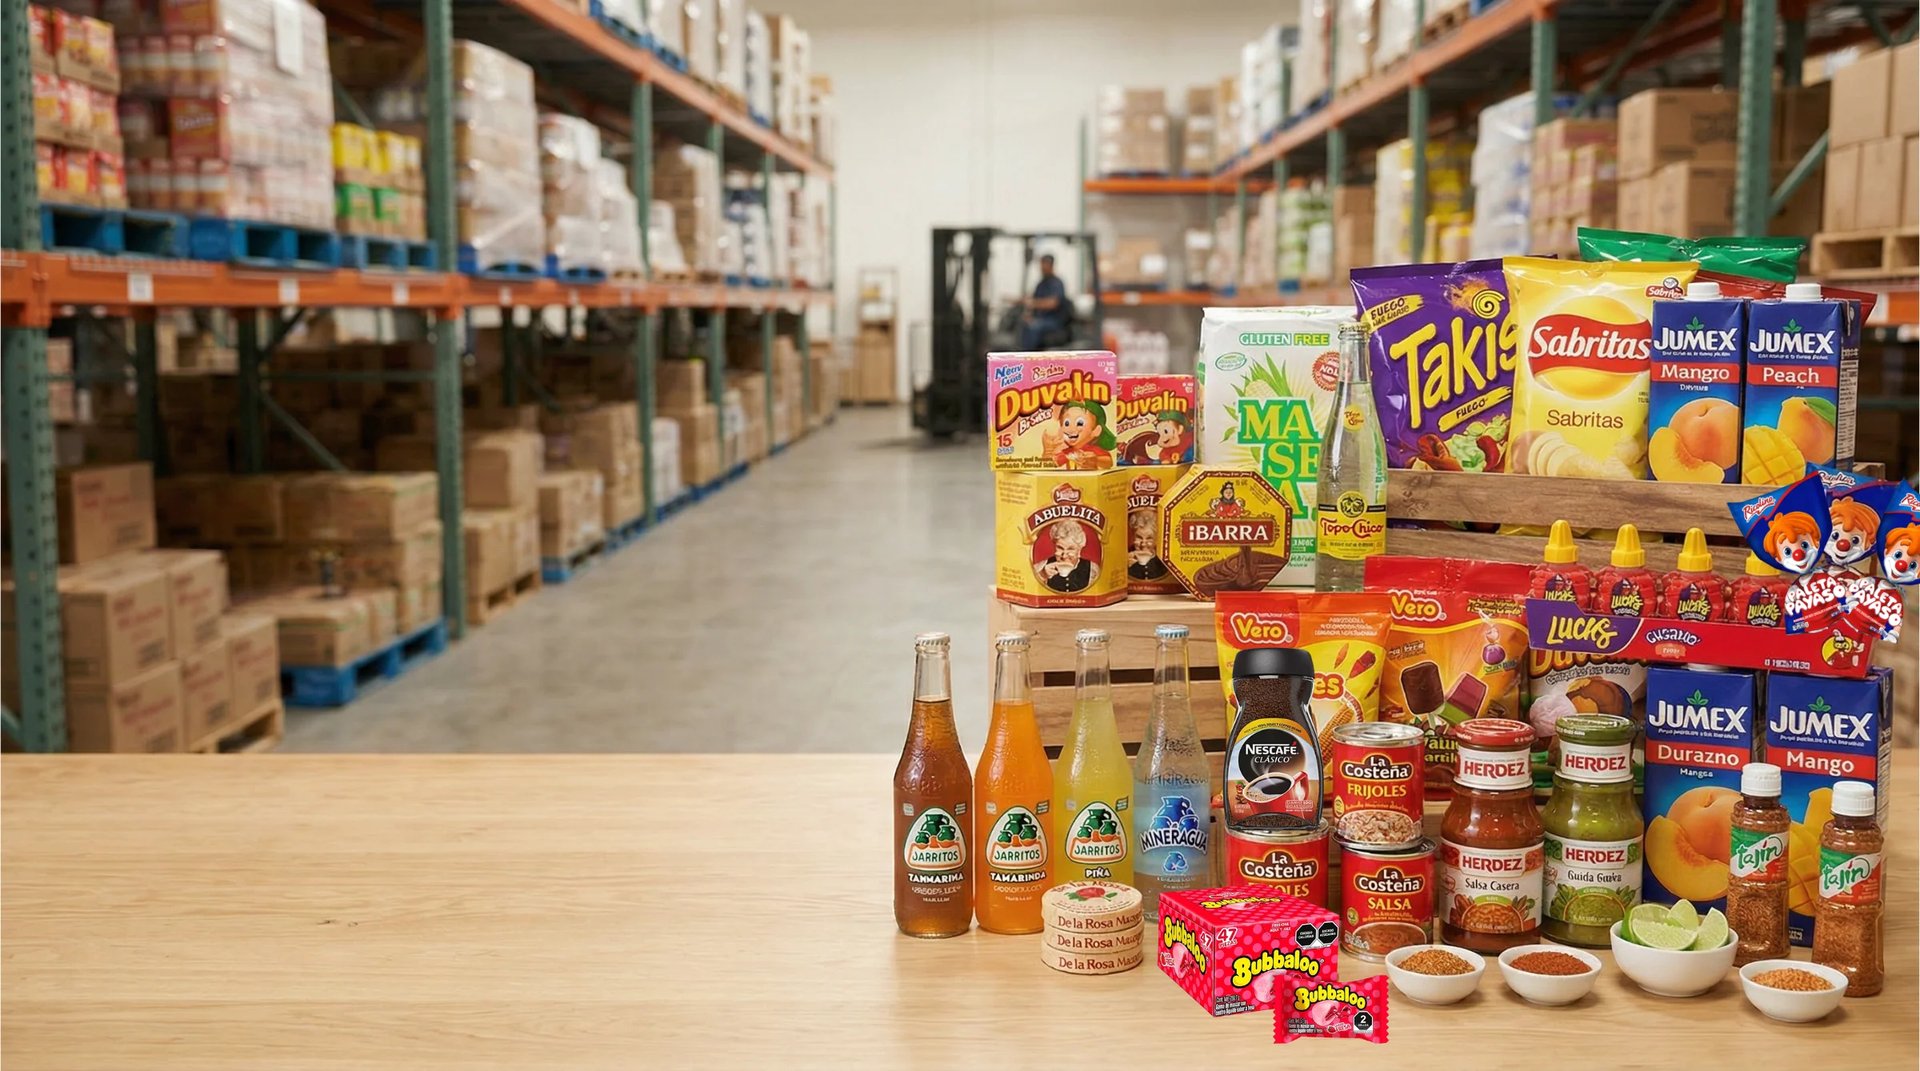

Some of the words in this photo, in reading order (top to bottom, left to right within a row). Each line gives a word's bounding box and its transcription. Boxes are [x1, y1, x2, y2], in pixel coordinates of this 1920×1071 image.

[1239, 333, 1292, 346] GLUTEN
[1294, 333, 1330, 346] FREE
[1528, 326, 1652, 360] Sabritas
[1654, 327, 1738, 355] JUMEX
[1750, 330, 1836, 354] JUMEX
[1390, 317, 1517, 429] Takis
[1763, 368, 1820, 383] Peach
[997, 370, 1111, 430] Duvalín
[1547, 409, 1623, 429] Sabritas
[997, 434, 1012, 448] 15
[1034, 505, 1101, 526] ABUELITA
[1788, 577, 1836, 601] PALETA
[1860, 578, 1902, 614] PALETA
[1391, 595, 1437, 616] Vero
[1785, 585, 1846, 616] PAYASO
[1236, 618, 1282, 638] Vero
[1648, 700, 1748, 733] JUMEX
[1769, 705, 1873, 741] JUMEX
[1245, 741, 1300, 755] NESCAFÉ
[1657, 745, 1740, 766] Durazno
[1254, 755, 1291, 764] CLÁSICO
[1370, 757, 1386, 767] La
[1565, 754, 1627, 773] HERDEZ
[1787, 751, 1855, 777] Mango
[1345, 764, 1409, 779] Costeña
[1464, 760, 1525, 779] HERDEZ
[1347, 783, 1407, 800] FRIJOLES
[1074, 844, 1120, 856] JARRITOS
[1141, 830, 1209, 853] MINERAGUA
[912, 850, 958, 862] JARRITOS
[994, 849, 1040, 862] JARRITOS
[1271, 853, 1288, 864] La
[1462, 856, 1523, 872] HERDEZ
[1565, 847, 1625, 864] HERDEZ
[1244, 862, 1313, 878] Costeña
[1383, 869, 1398, 880] La
[1358, 877, 1420, 892] Costeña
[1465, 878, 1487, 890] Salsa
[1490, 881, 1520, 891] Casera
[1368, 897, 1412, 911] SALSA
[1058, 915, 1073, 928] De
[1073, 918, 1083, 929] la
[1085, 918, 1113, 929] Rosa
[1057, 934, 1071, 947] De
[1072, 937, 1082, 948] la
[1084, 938, 1113, 949] Rosa
[1200, 932, 1212, 947] 47
[1217, 928, 1237, 941] 47
[1164, 916, 1206, 973] Bubbaloo
[1059, 956, 1073, 968] De
[1074, 958, 1085, 970] la
[1087, 959, 1115, 970] Rosa
[1232, 950, 1320, 987] Bubbaloo
[1294, 984, 1366, 1011] Bubbaloo
[1360, 1015, 1368, 1024] 2
